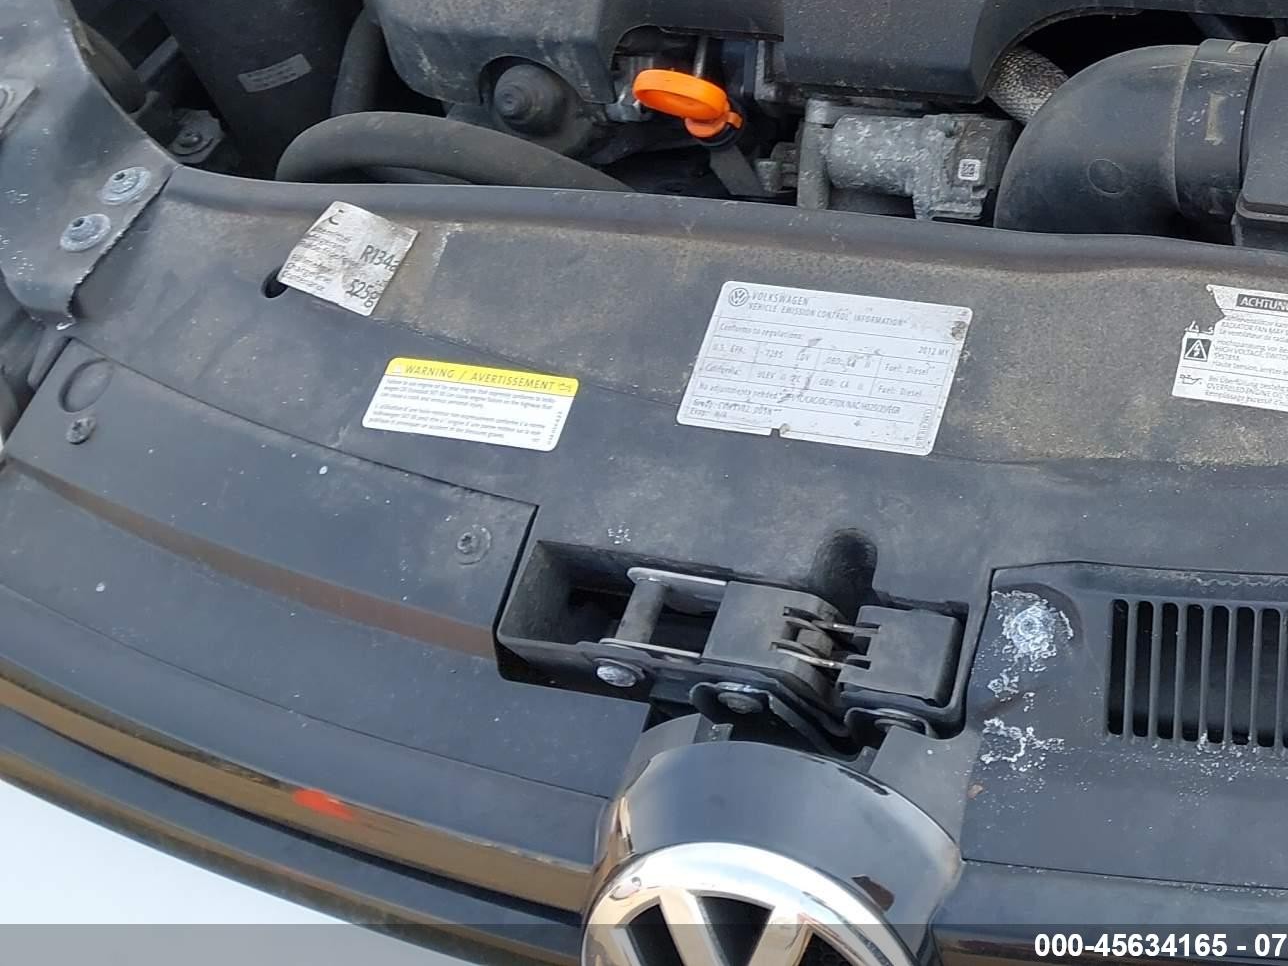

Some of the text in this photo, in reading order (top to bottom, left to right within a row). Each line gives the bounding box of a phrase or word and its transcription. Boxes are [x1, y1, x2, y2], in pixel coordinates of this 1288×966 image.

[752, 292, 810, 306] VOLKSWAGEN
[747, 302, 778, 313] VEHICLE
[780, 306, 816, 317] EMISSION
[917, 346, 938, 355] 2012
[405, 364, 456, 379] WARNING
[470, 372, 556, 390] AVERTISSEMENT
